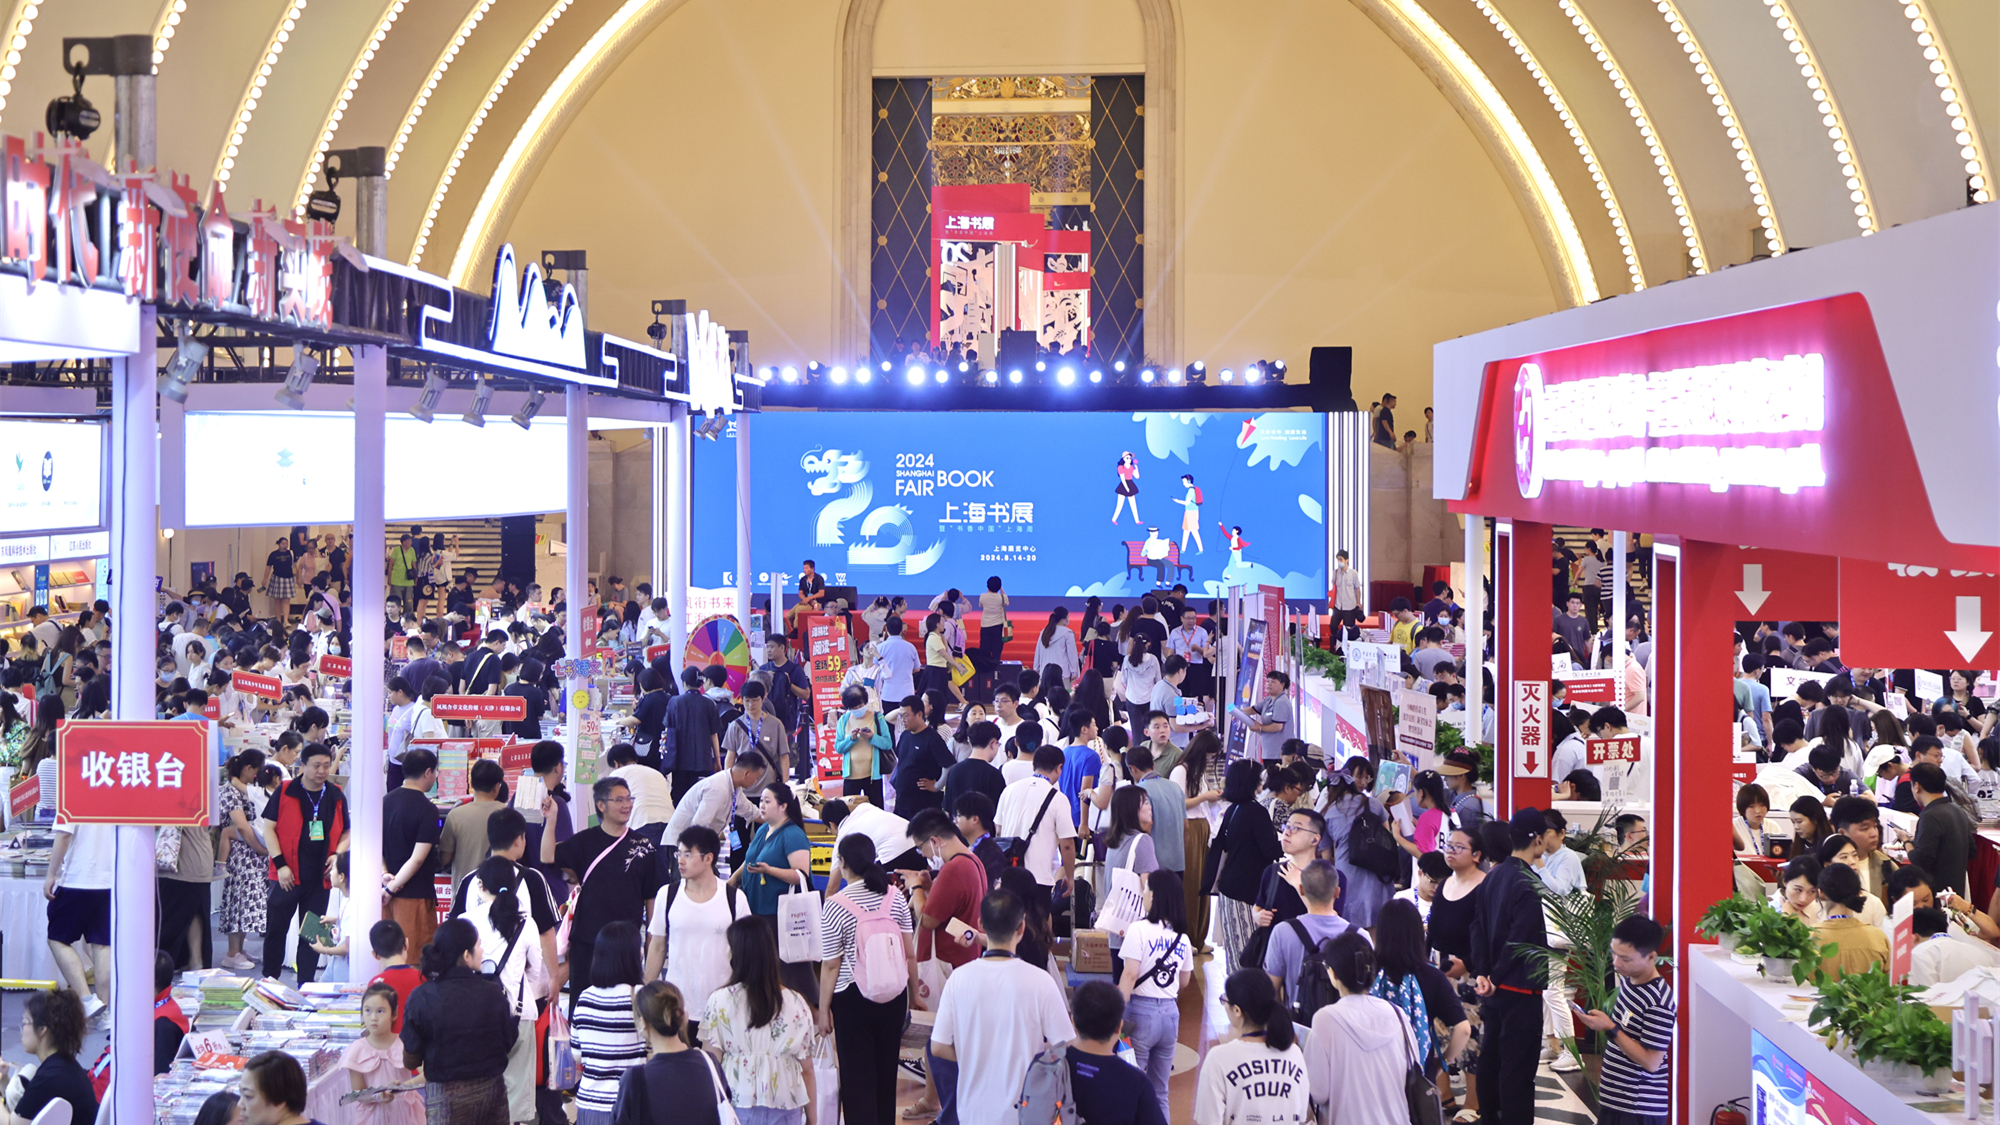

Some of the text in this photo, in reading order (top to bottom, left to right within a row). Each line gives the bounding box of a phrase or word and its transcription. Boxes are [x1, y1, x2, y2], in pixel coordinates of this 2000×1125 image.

[945, 215, 995, 230] 上海书展
[896, 453, 934, 468] 2024
[896, 479, 934, 496] FAIR
[937, 470, 994, 487] BOOK
[939, 502, 1034, 523] 上海书展
[812, 636, 846, 656] 阅读一夏
[552, 659, 602, 680] 七彩语文
[1521, 683, 1541, 746] 灭火器
[1593, 741, 1634, 760] 开票处
[81, 750, 185, 788] 收银台
[1148, 936, 1187, 960] YANEE
[1226, 1059, 1303, 1087] POSITIVE
[1242, 1081, 1292, 1100] TOUR
